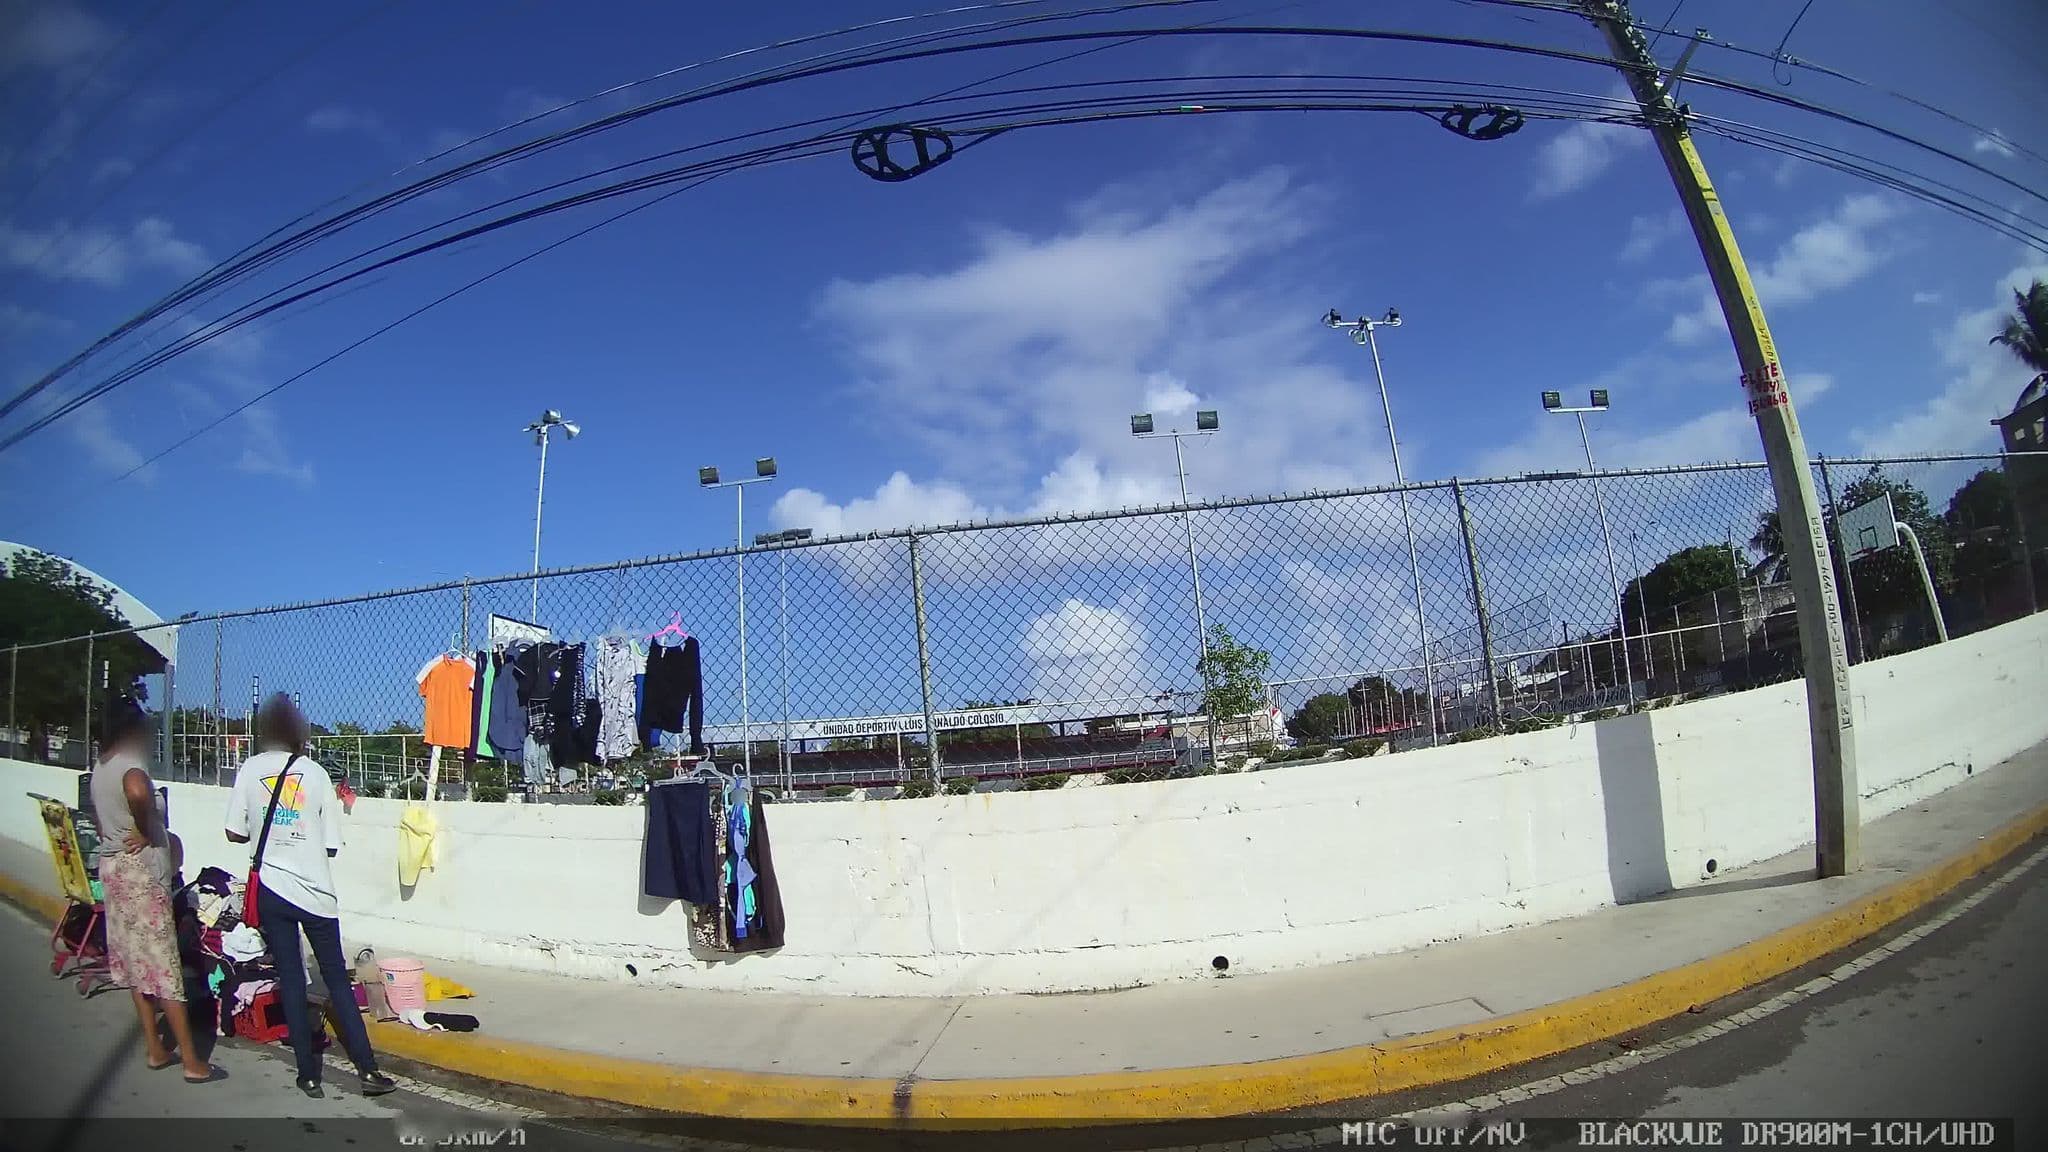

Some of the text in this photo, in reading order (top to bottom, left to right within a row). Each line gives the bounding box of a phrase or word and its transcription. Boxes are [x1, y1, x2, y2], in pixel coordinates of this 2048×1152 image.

[823, 722, 854, 736] UNIDAD
[904, 718, 923, 731] LUIS
[933, 714, 966, 729] ONALDO
[967, 712, 1005, 726] COLOSIO
[262, 806, 299, 820] SRING
